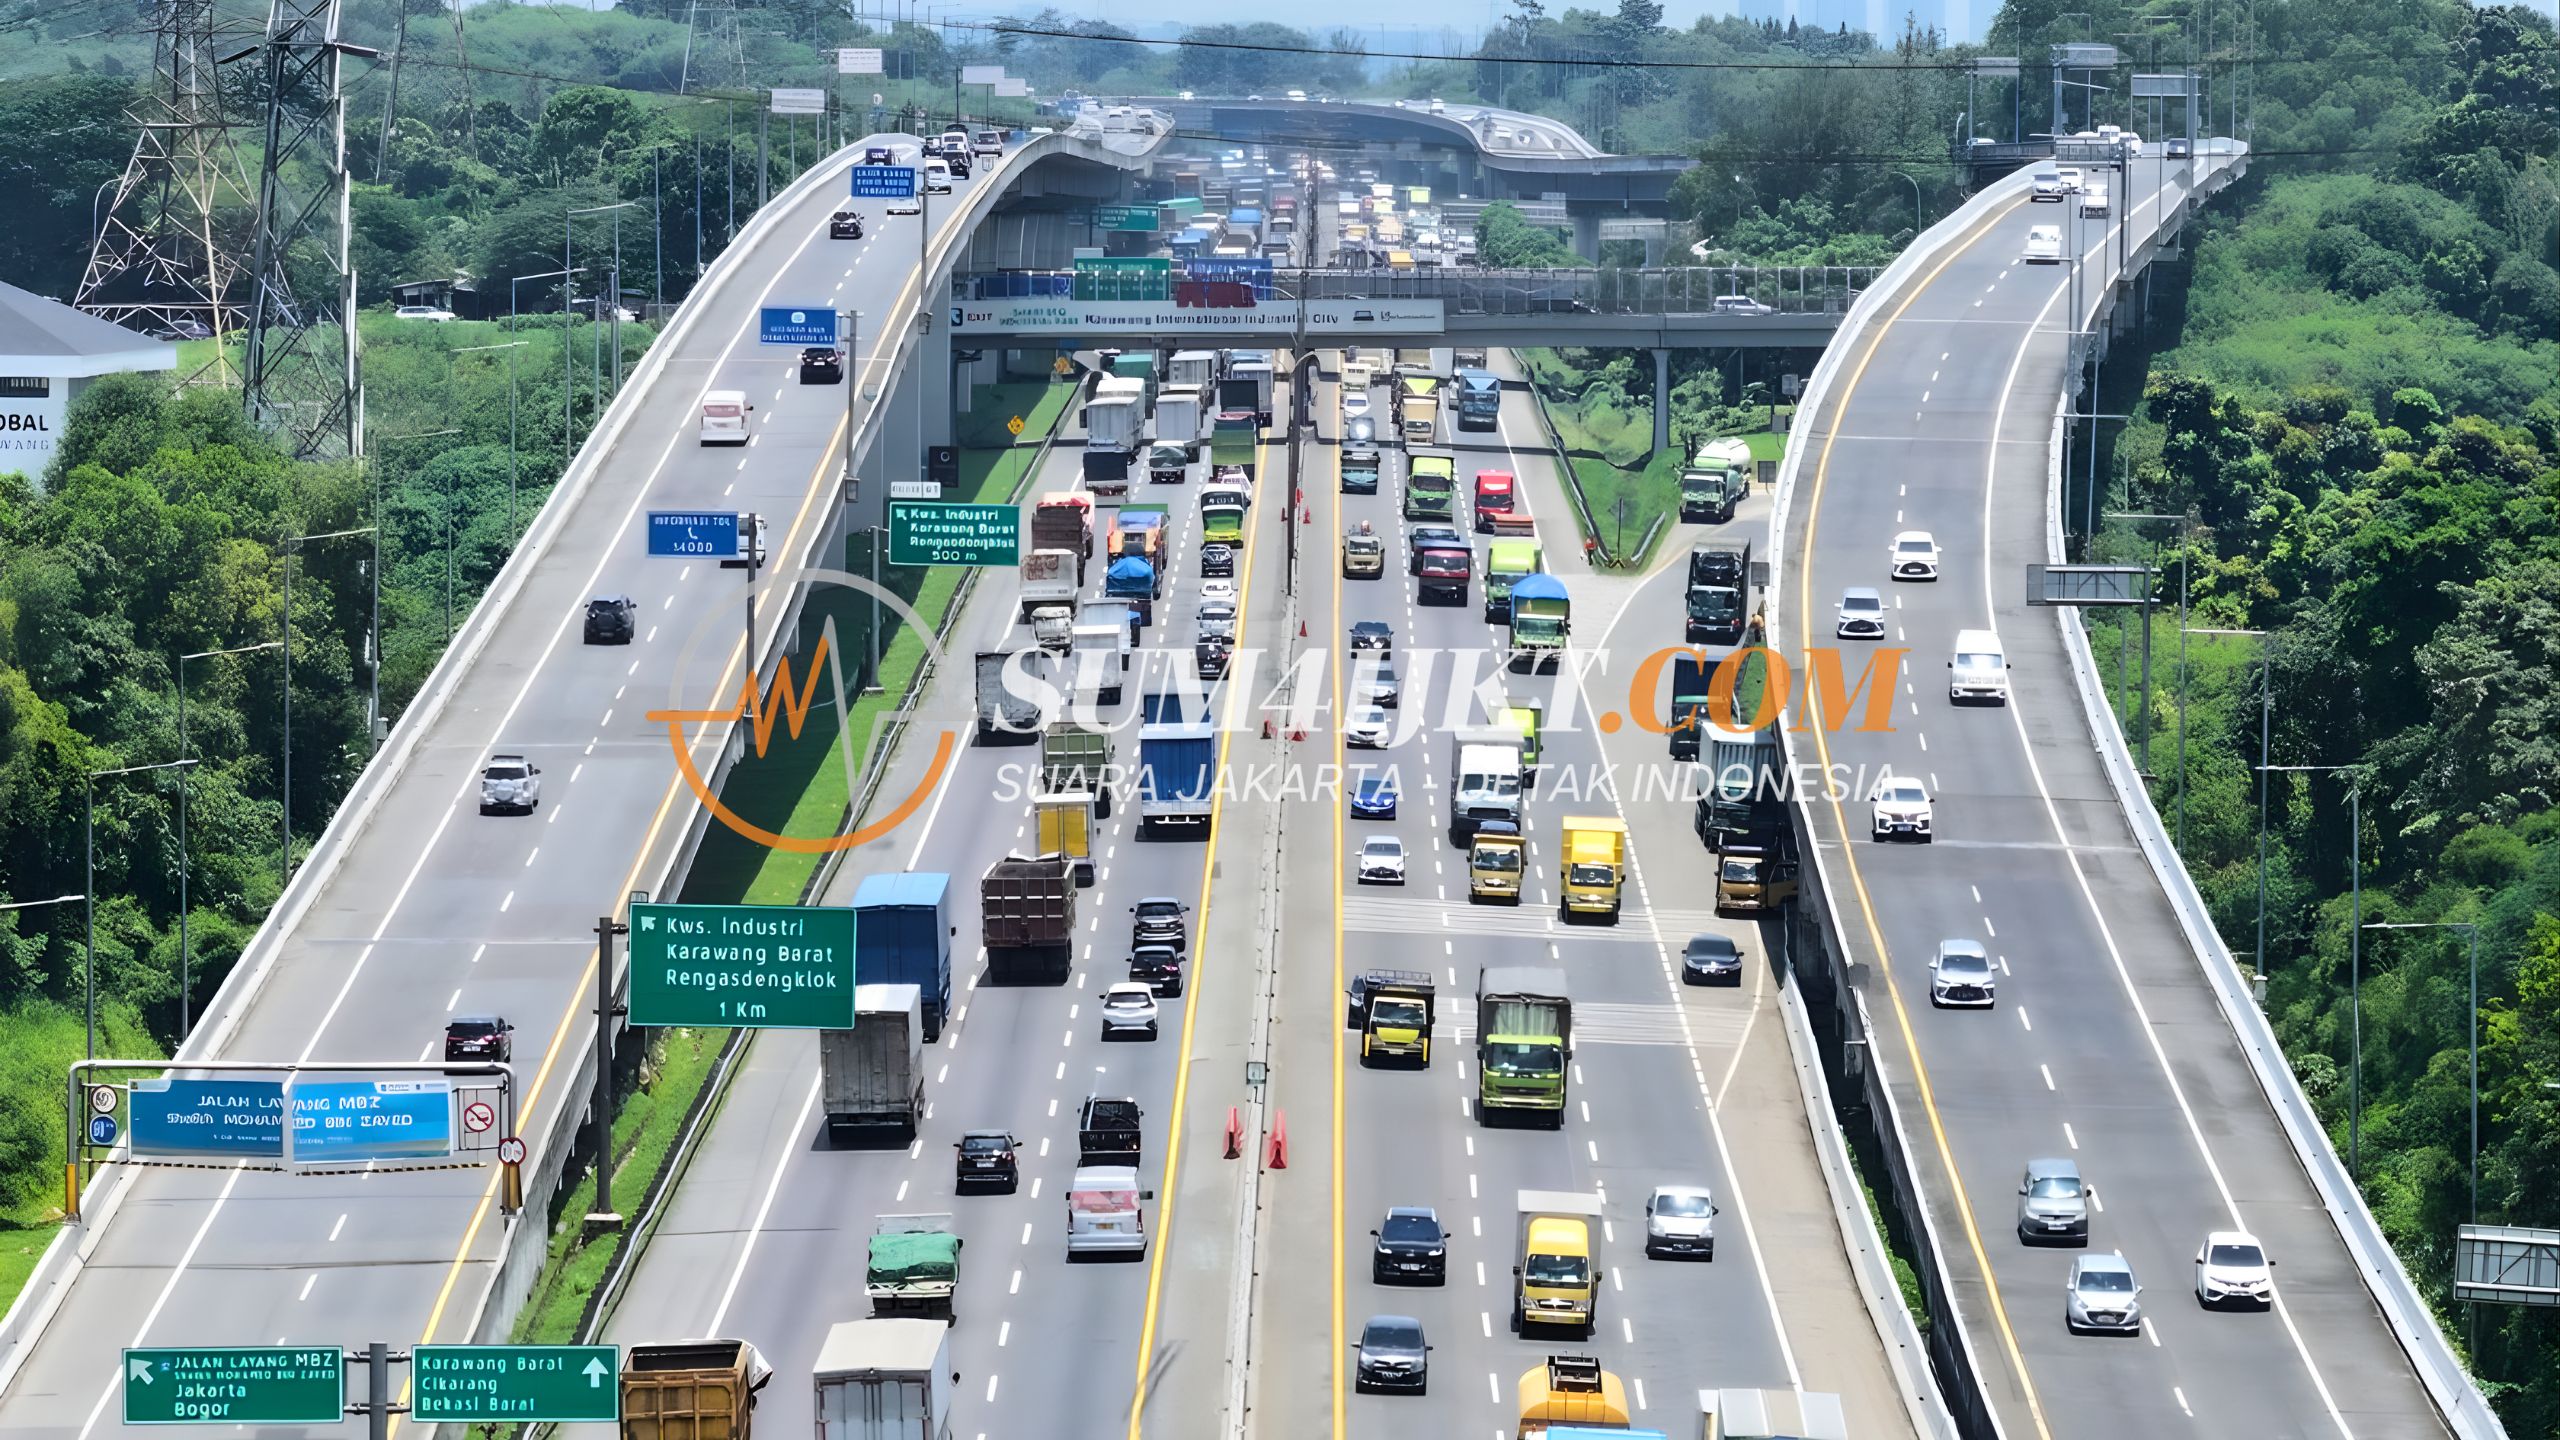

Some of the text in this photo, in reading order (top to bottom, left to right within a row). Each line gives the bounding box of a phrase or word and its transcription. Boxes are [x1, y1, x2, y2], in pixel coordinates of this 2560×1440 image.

[932, 550, 960, 561] 500
[667, 916, 804, 936] Kws. Industri
[666, 943, 833, 966] Karawang Barat
[666, 968, 837, 993] Rengasdengklok
[719, 1001, 767, 1018] 1 Km
[174, 1352, 333, 1370] JALAN LAYANG MBZ
[422, 1356, 564, 1374] Karawang Barat
[175, 1383, 247, 1398] Jakarta
[422, 1376, 498, 1395] Cikarang
[174, 1401, 231, 1420] Bogor
[422, 1396, 535, 1412] Bekasi Barat
